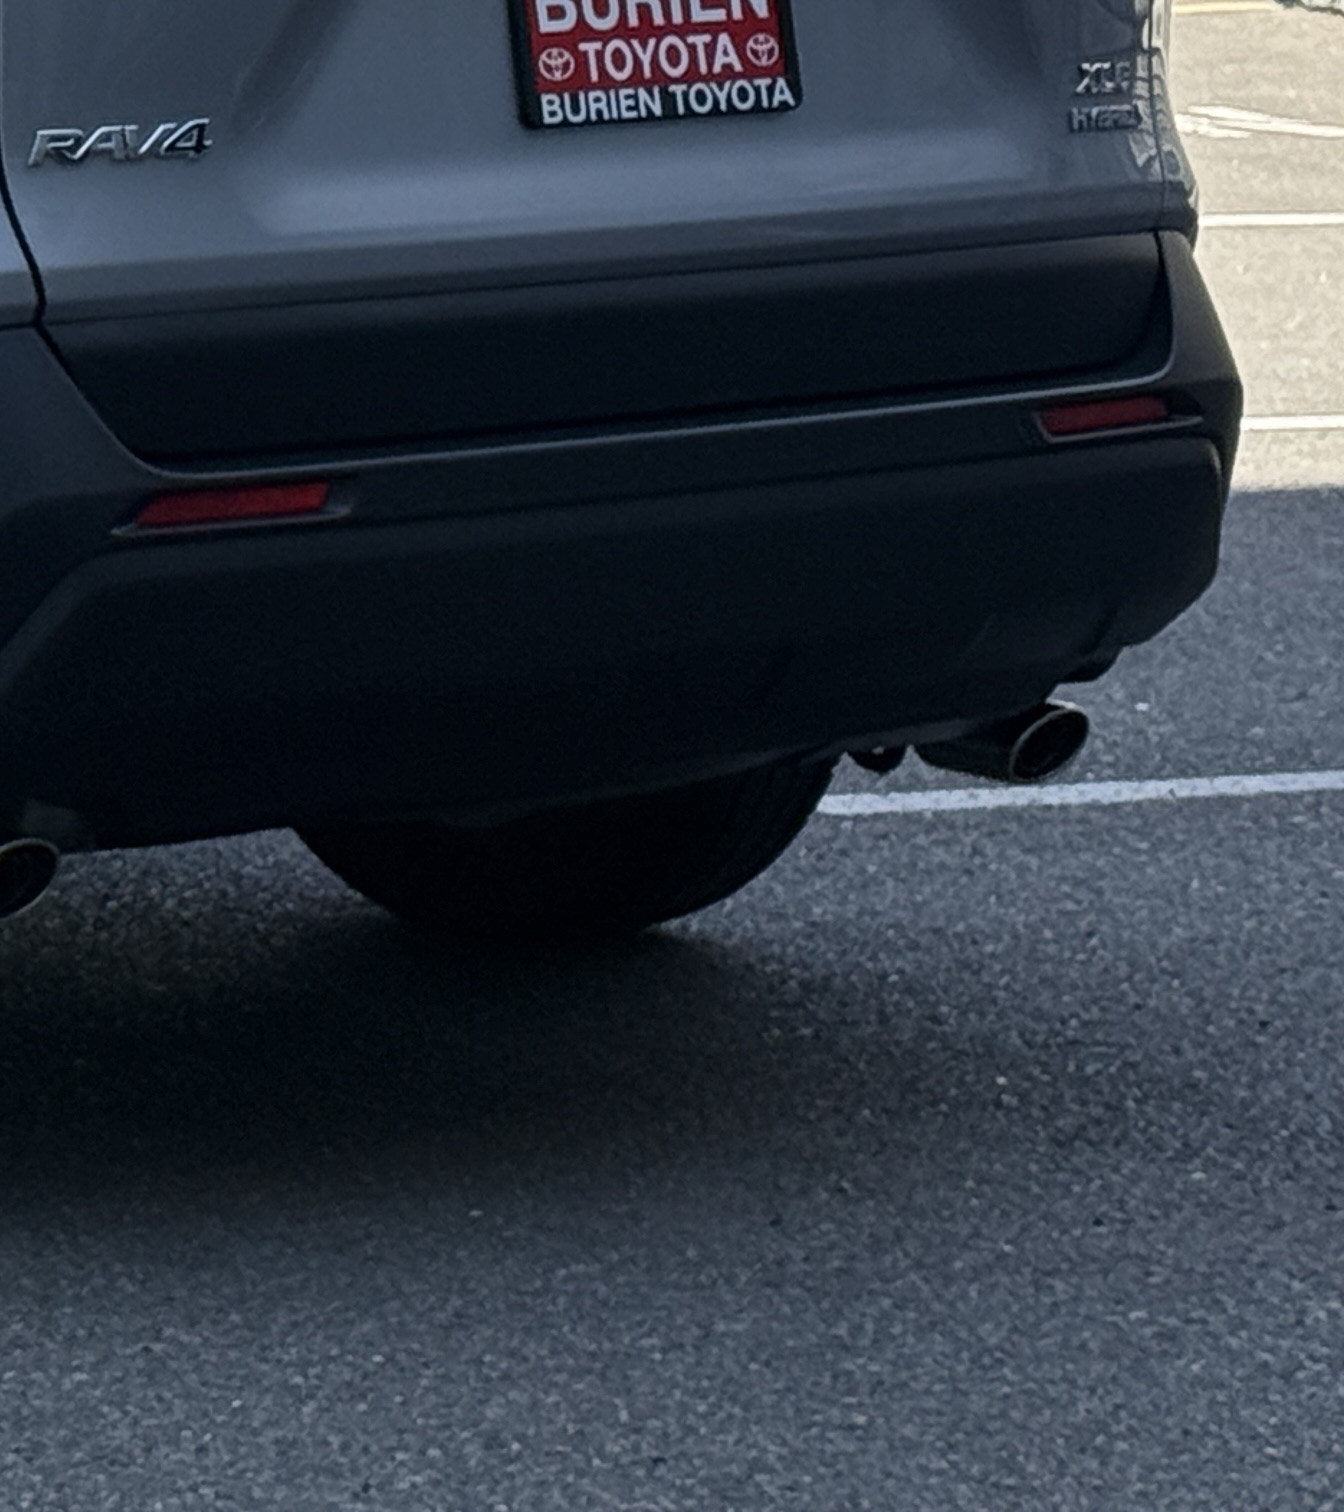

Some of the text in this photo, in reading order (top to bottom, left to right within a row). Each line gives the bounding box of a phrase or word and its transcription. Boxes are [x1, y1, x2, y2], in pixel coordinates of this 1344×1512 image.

[578, 33, 744, 83] TOYOTA
[541, 79, 796, 125] BURIEN TOYOTA
[28, 117, 212, 166] RAV4
